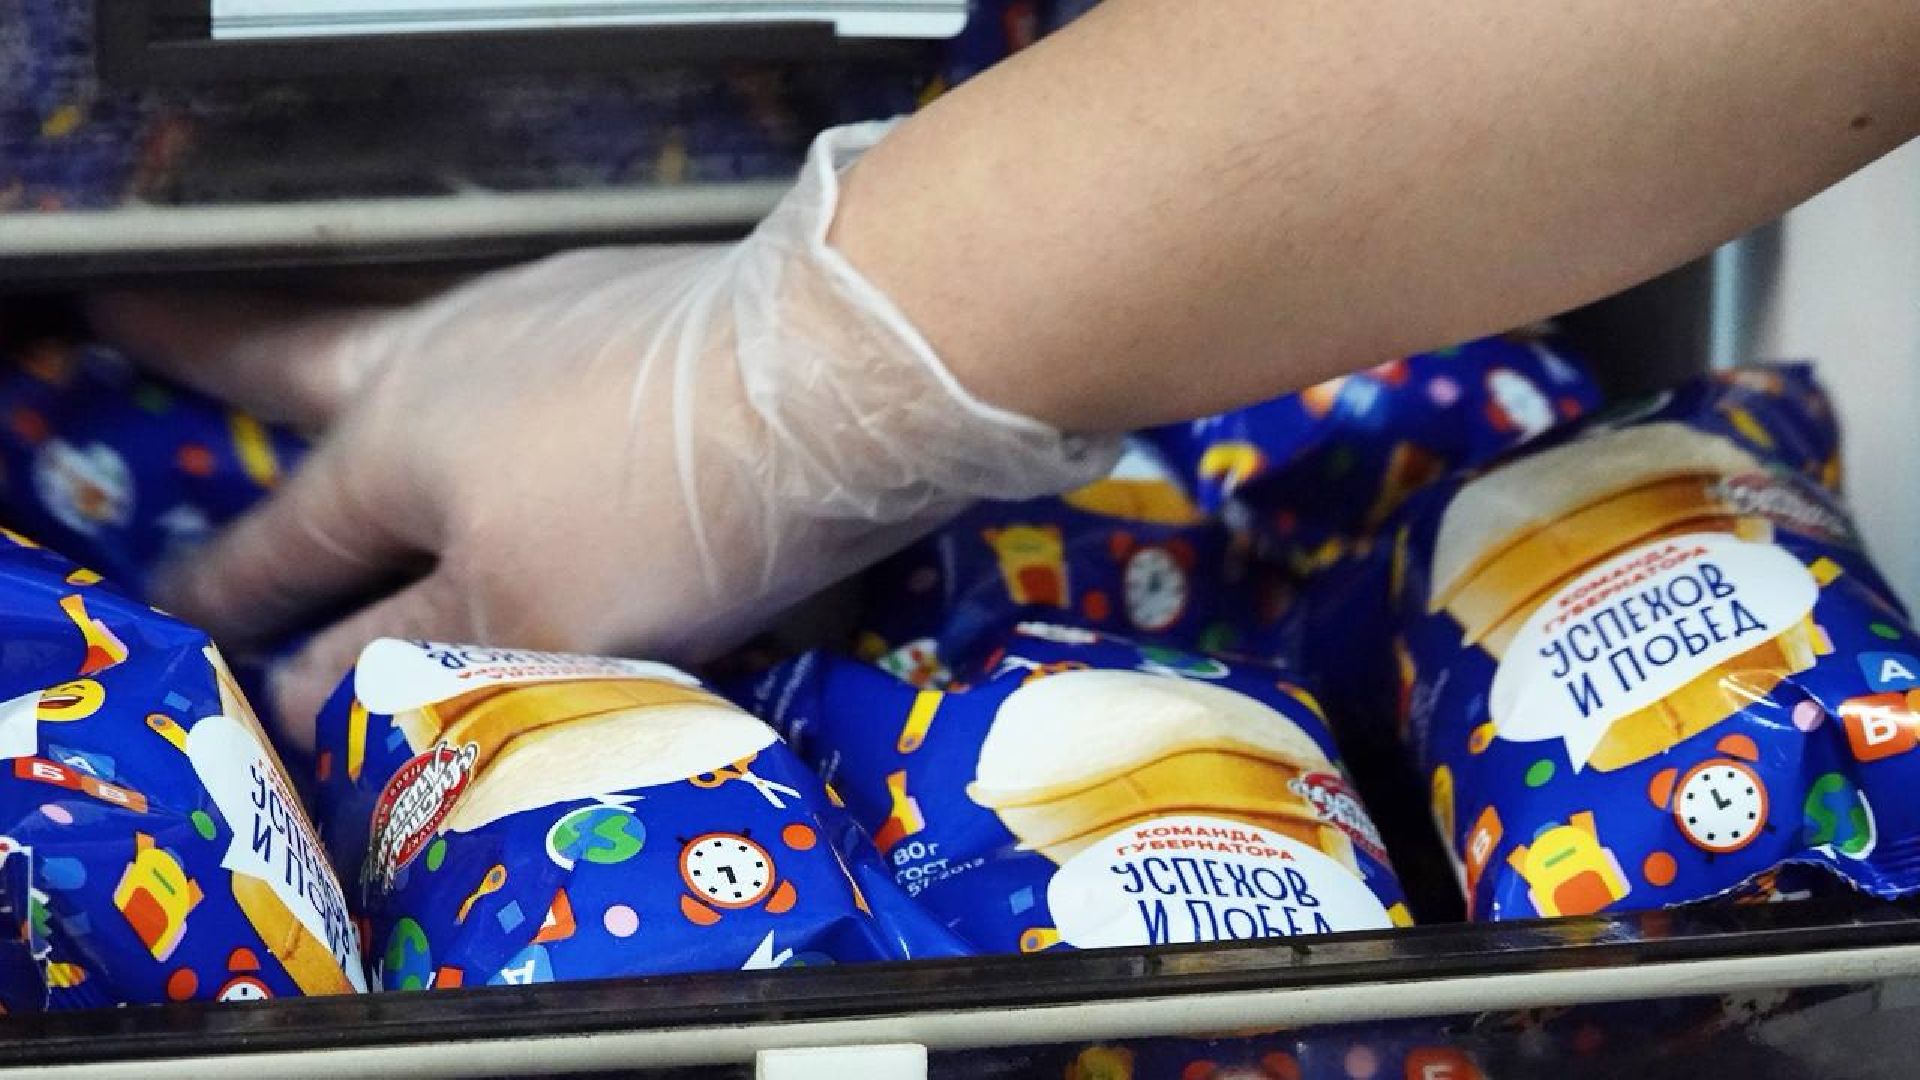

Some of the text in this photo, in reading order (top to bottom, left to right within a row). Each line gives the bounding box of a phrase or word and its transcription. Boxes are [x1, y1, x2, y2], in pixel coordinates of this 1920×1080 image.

[1538, 562, 1737, 679] УСПЕХОВ
[1565, 599, 1768, 718] И ПОБЕД
[1880, 658, 1916, 683] А
[252, 812, 272, 863] И
[1116, 839, 1296, 861] ГУБЕРНАТОРА
[1136, 824, 1267, 844] КОМАНДА
[1110, 856, 1321, 907] УСПЕХОВ
[1137, 899, 1170, 945] И
